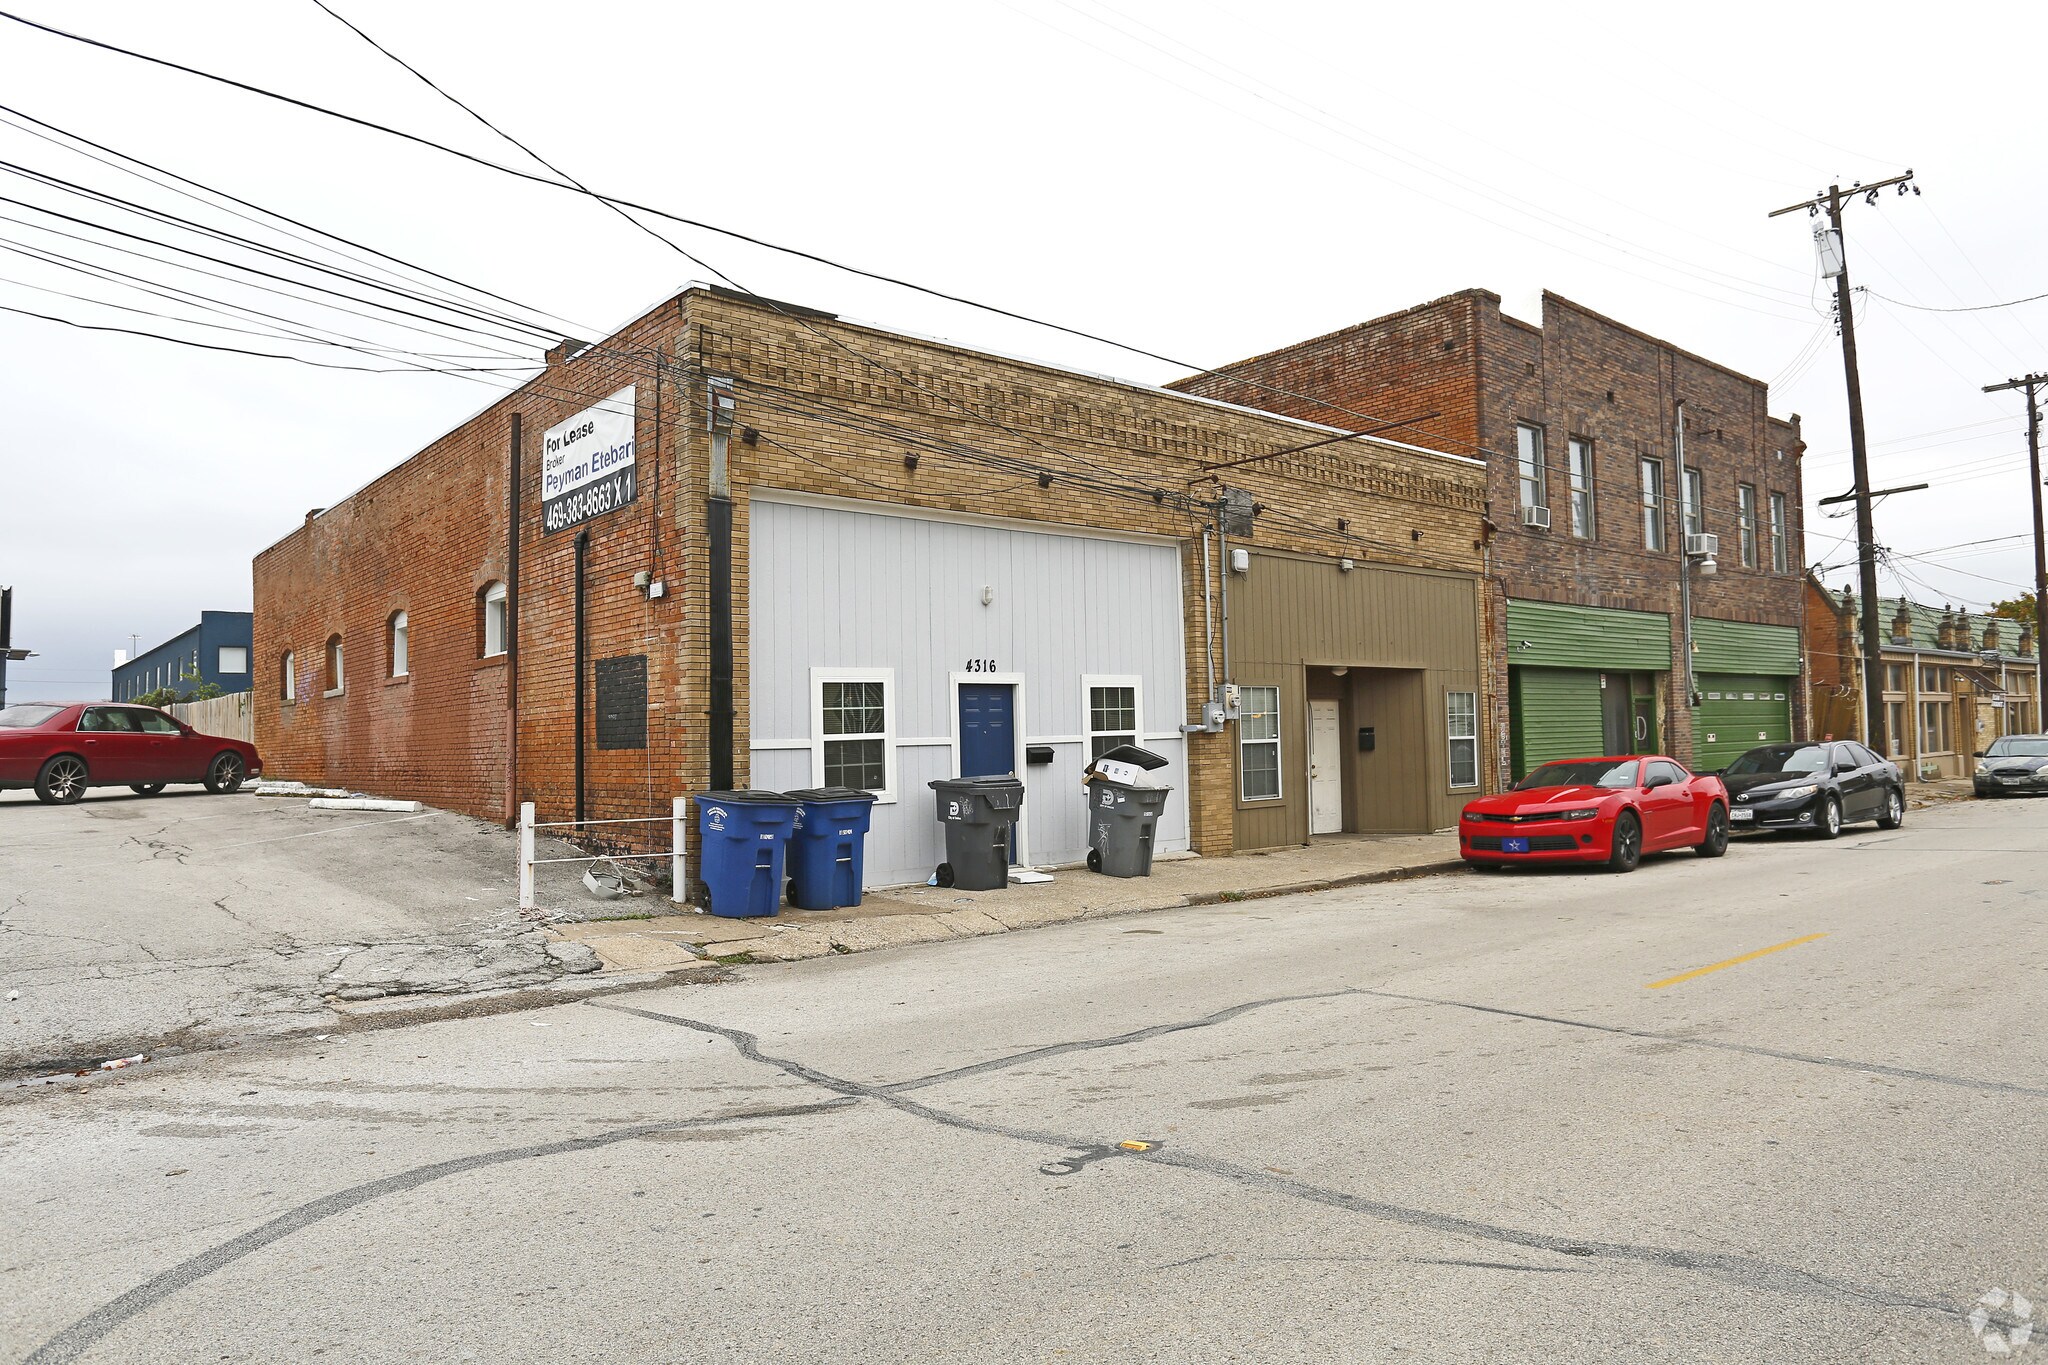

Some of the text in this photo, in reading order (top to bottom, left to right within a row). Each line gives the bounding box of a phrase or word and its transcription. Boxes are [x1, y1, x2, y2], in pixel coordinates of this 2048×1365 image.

[546, 421, 594, 455] For Lease
[546, 454, 565, 471] Broker
[546, 436, 635, 493] Peyman Etebari
[547, 473, 631, 531] 469-383-8663 X 1
[966, 658, 996, 673] 4316
